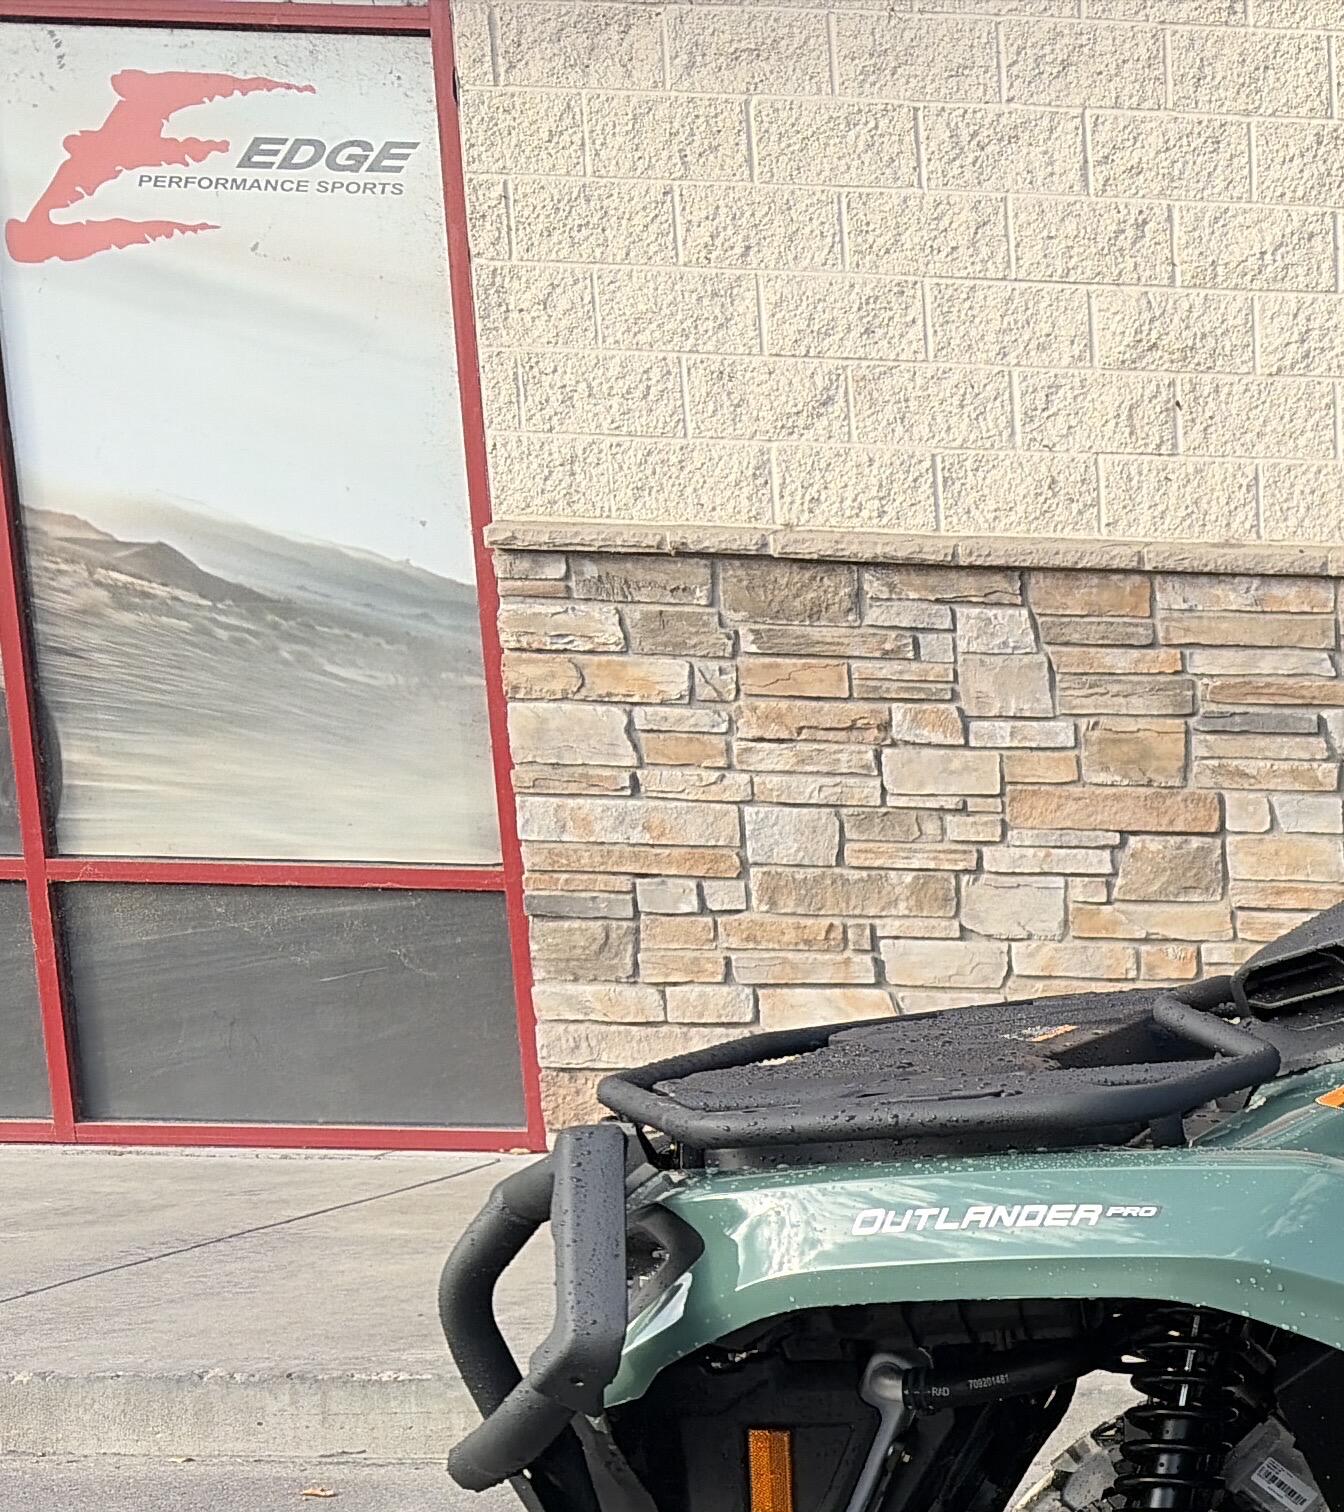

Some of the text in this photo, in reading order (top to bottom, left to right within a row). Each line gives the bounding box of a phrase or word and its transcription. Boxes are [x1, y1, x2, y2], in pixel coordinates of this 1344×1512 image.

[236, 136, 421, 173] EDGE
[138, 174, 405, 196] PERFORMANCE SPORTS
[851, 1204, 1159, 1236] OUTLANDER PRO
